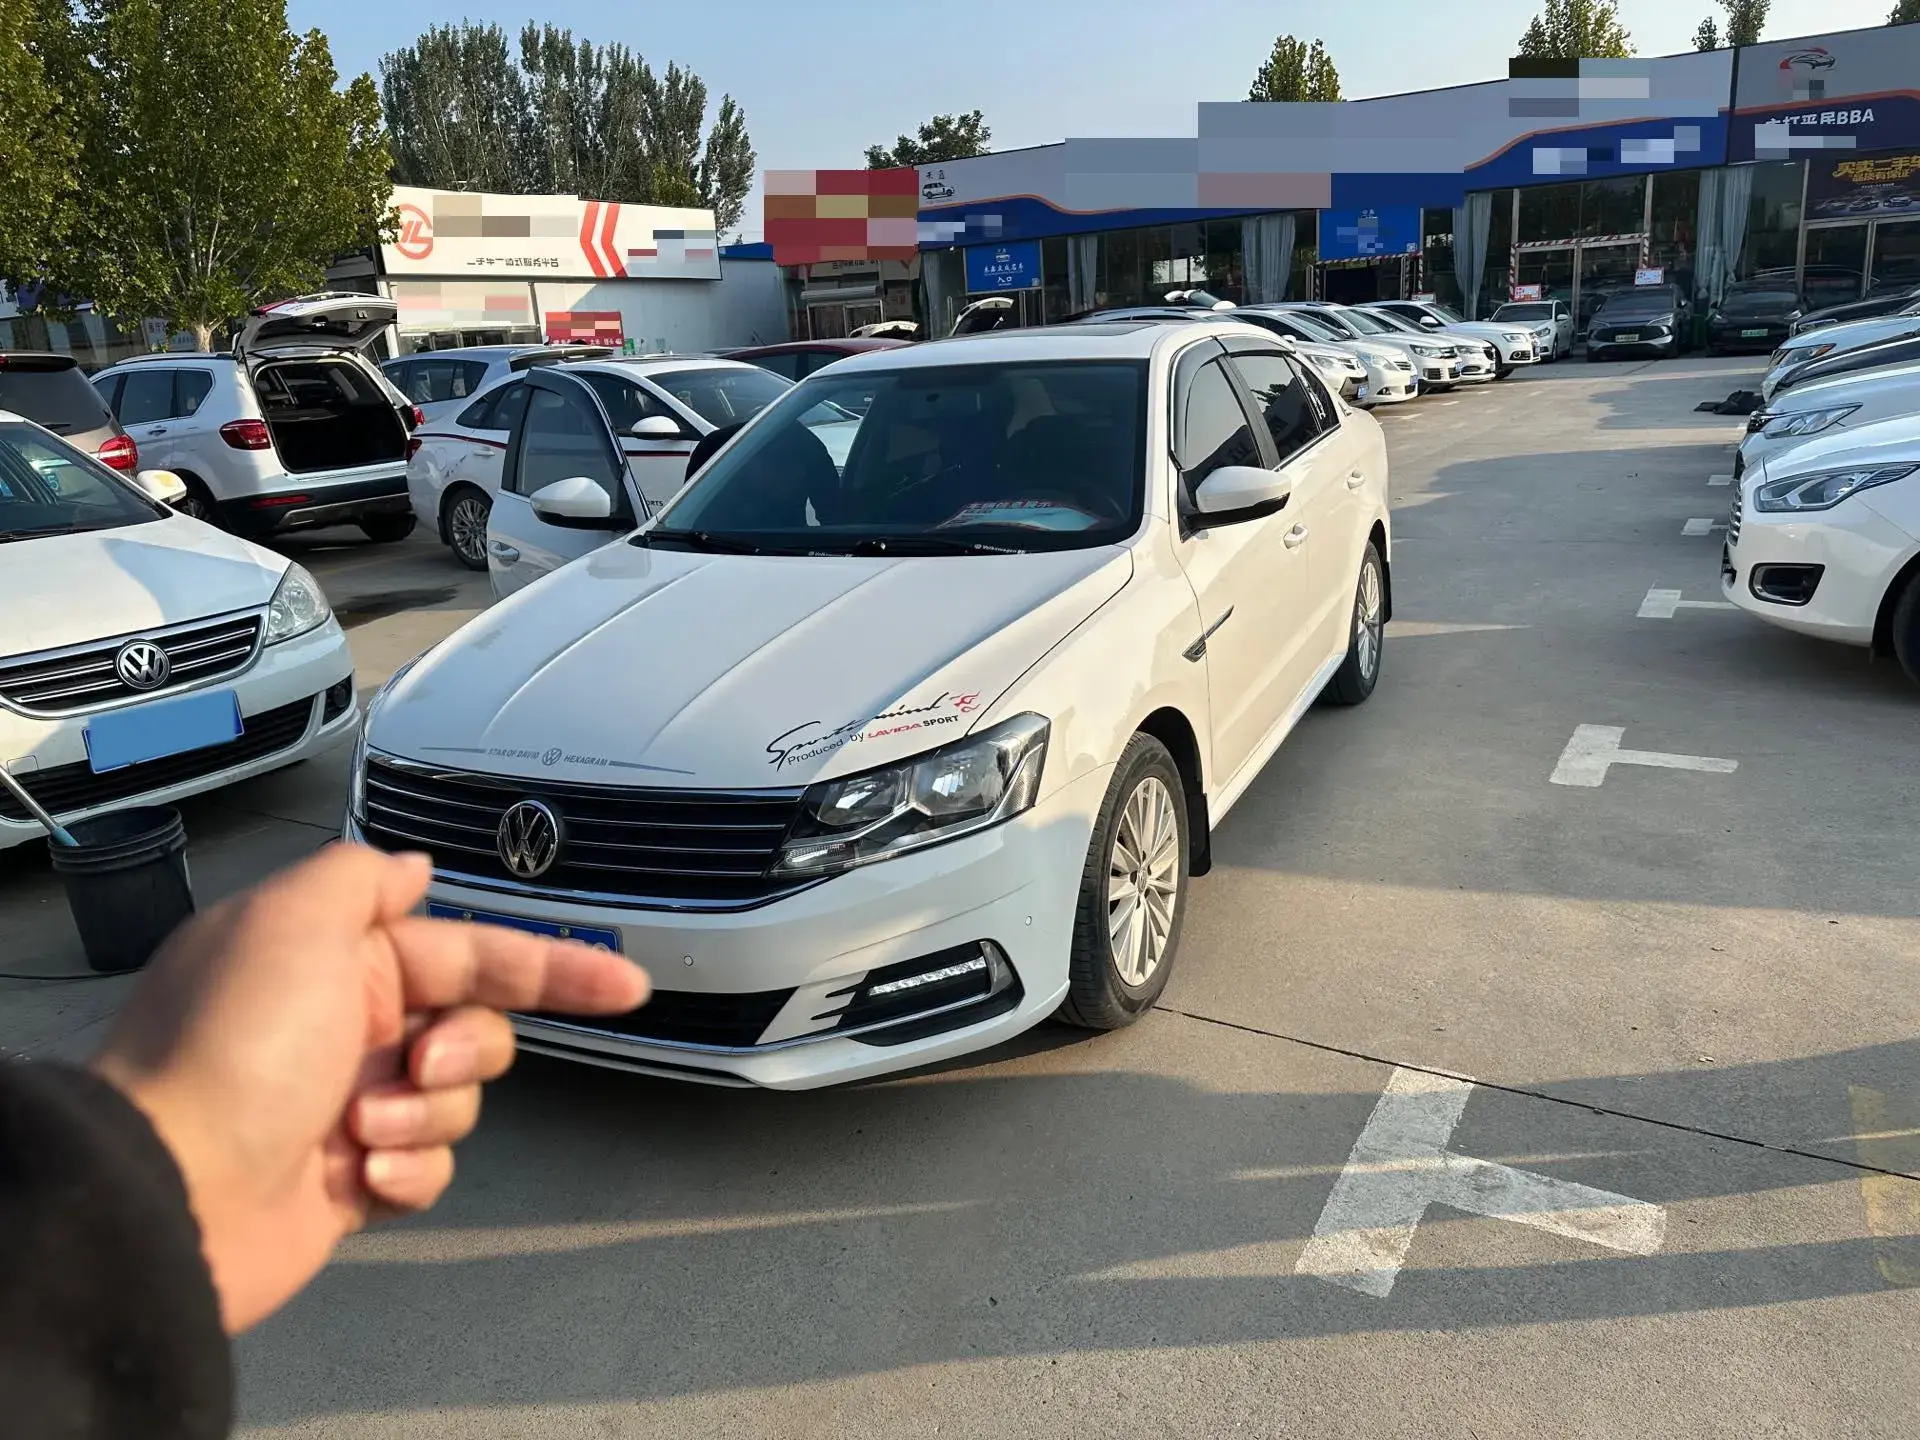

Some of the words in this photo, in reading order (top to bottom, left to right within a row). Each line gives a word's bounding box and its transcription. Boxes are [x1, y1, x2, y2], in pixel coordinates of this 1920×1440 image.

[786, 738, 844, 766] Produced
[849, 731, 865, 743] by
[922, 714, 960, 728] SPORT
[563, 754, 609, 766] HEXAGRAM
